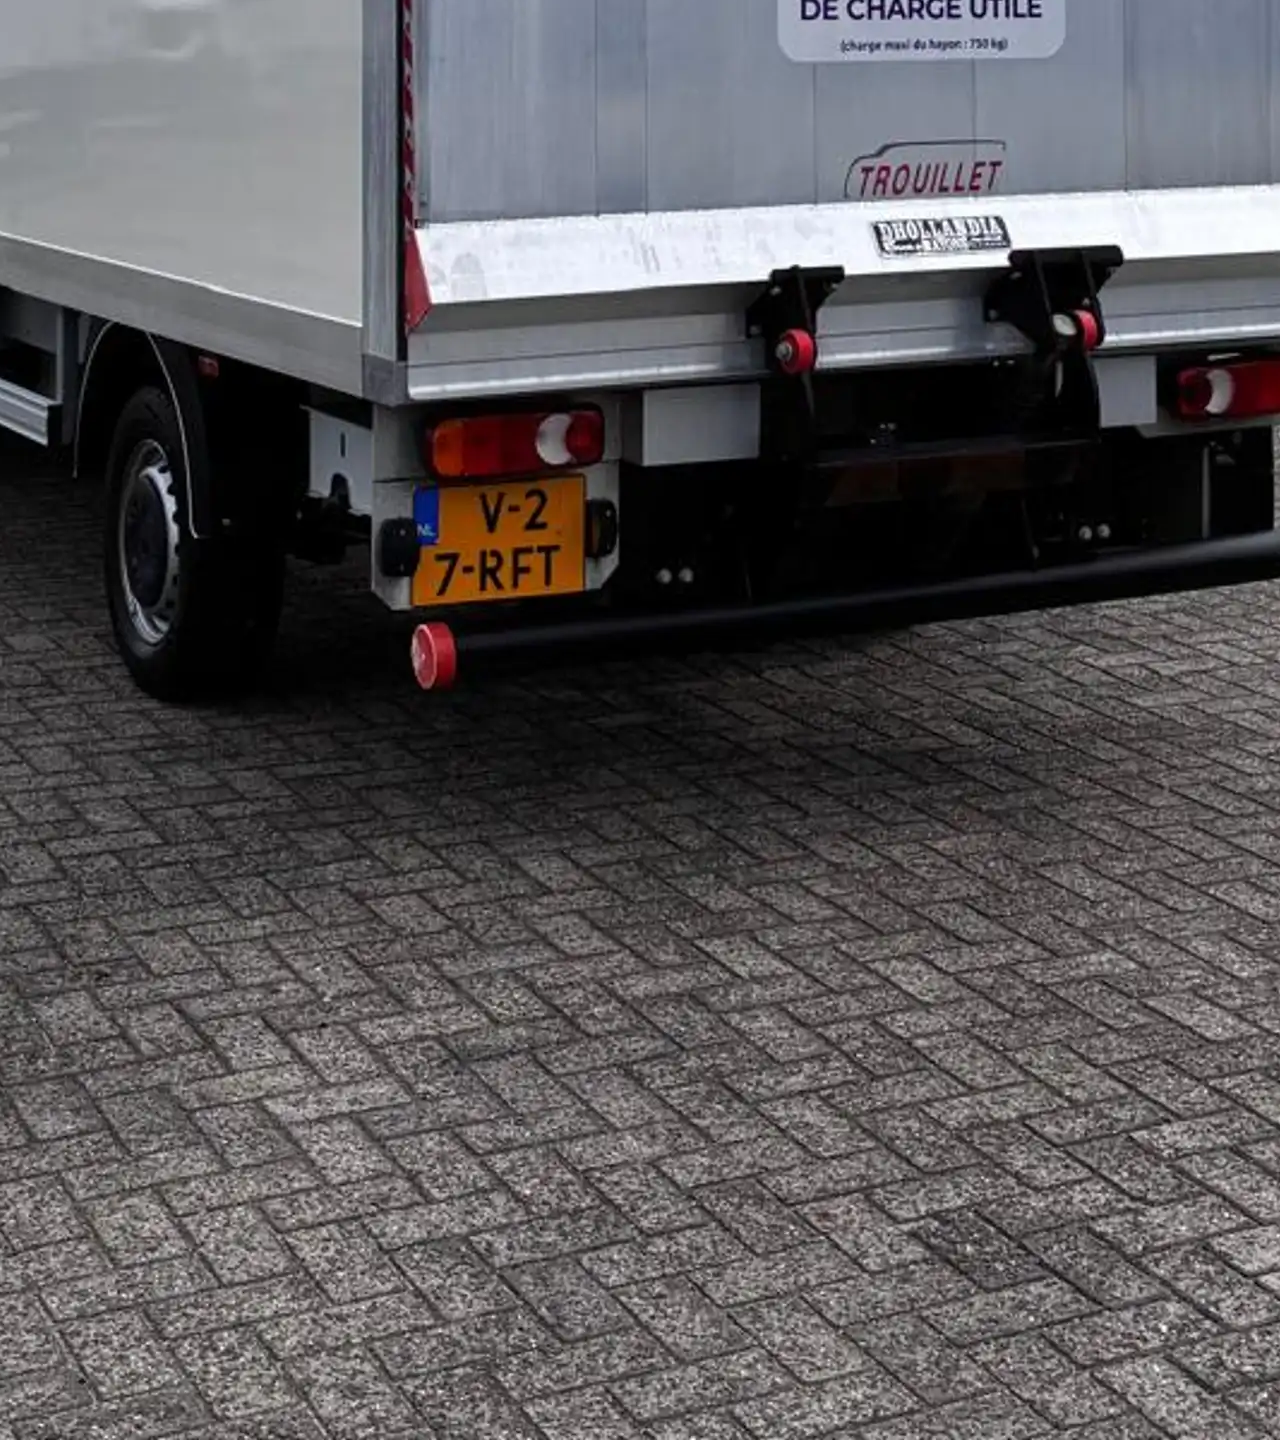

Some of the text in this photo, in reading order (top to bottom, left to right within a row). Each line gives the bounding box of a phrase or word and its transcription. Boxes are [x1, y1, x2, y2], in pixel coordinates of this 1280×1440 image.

[913, 37, 927, 51] du
[860, 161, 1003, 197] TROUILLET
[878, 217, 1003, 241] DHOLLANDIA
[479, 488, 549, 534] V-2
[416, 524, 436, 537] NL
[434, 544, 561, 596] 7-RFT
